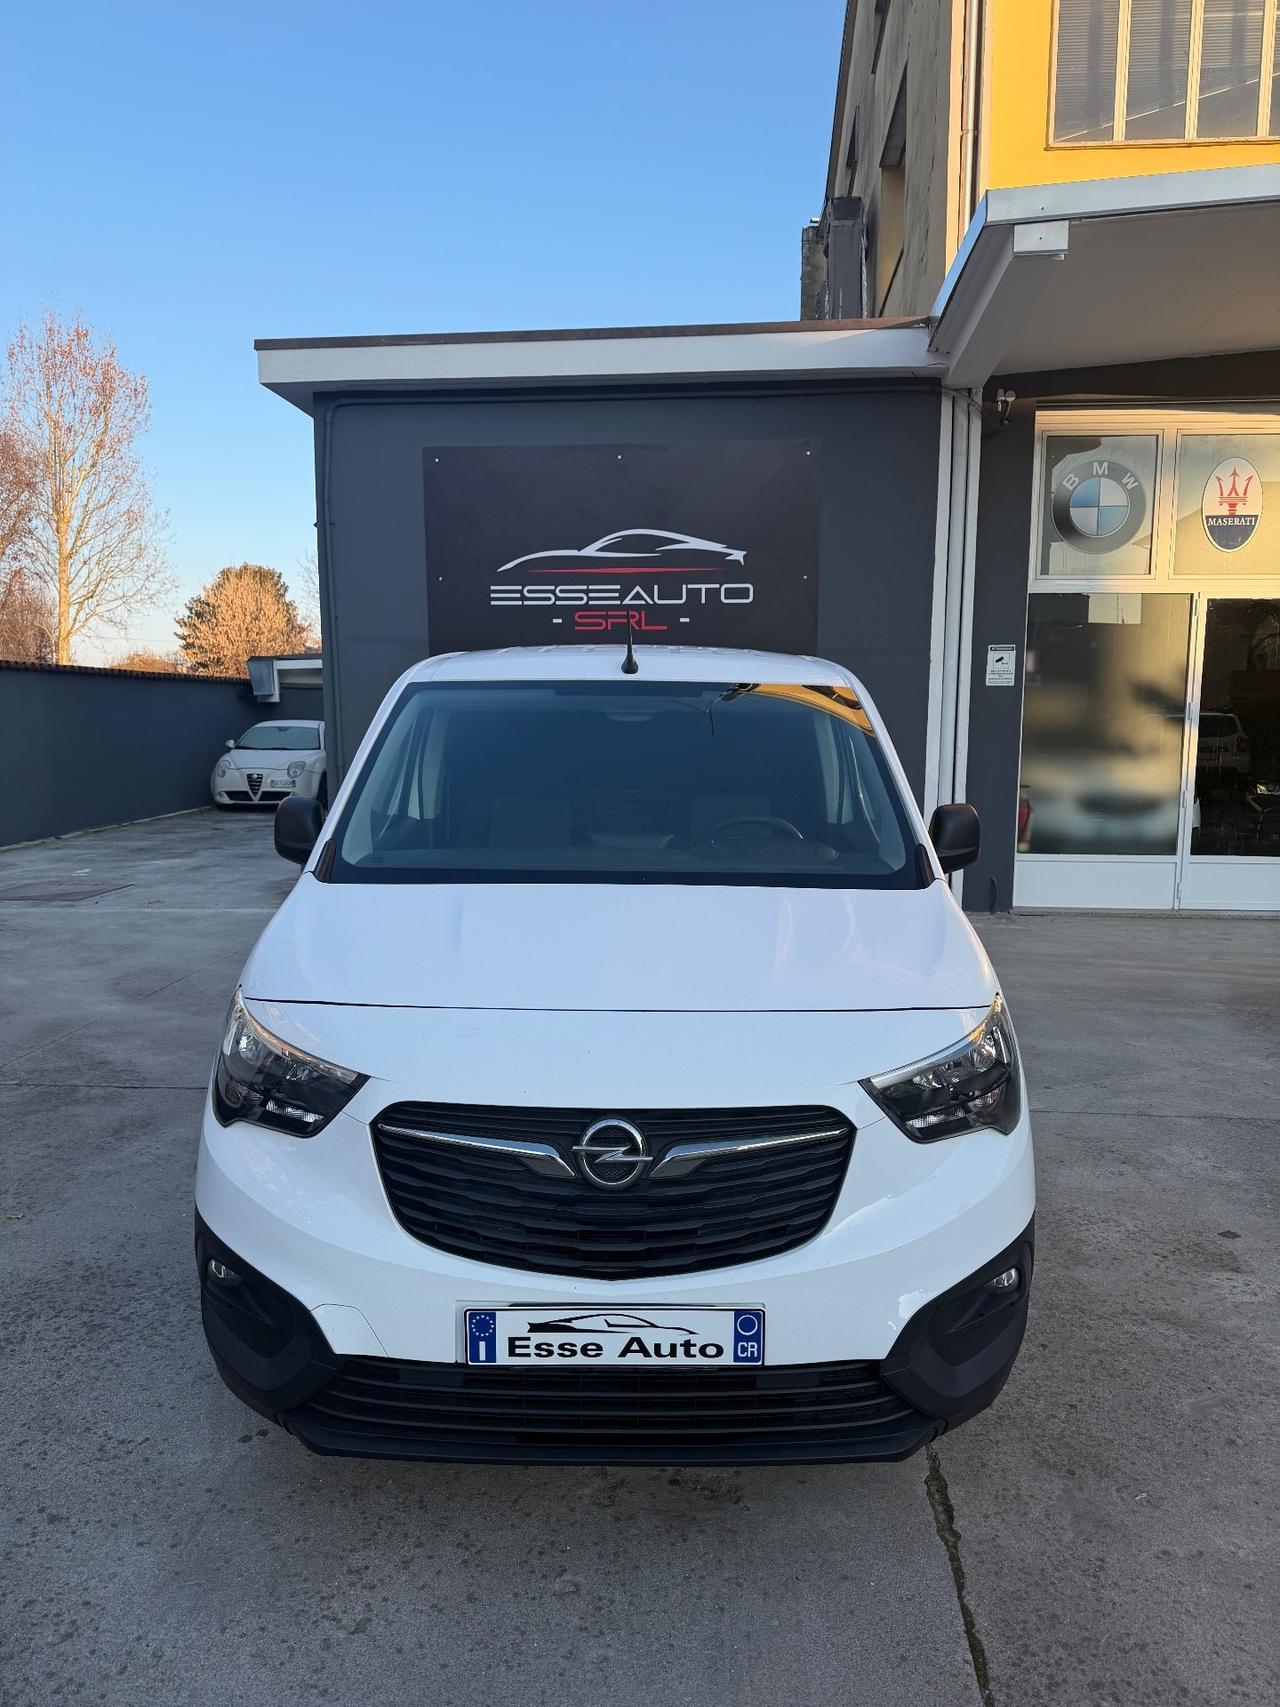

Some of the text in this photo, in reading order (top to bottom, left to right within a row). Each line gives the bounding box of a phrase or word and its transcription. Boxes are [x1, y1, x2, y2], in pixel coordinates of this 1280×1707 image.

[1062, 461, 1139, 491] BMW
[1207, 517, 1256, 526] MASERATI
[490, 583, 754, 605] ESSEAUTO
[507, 1336, 725, 1358] Esse Auto
[737, 1341, 758, 1358] CR
